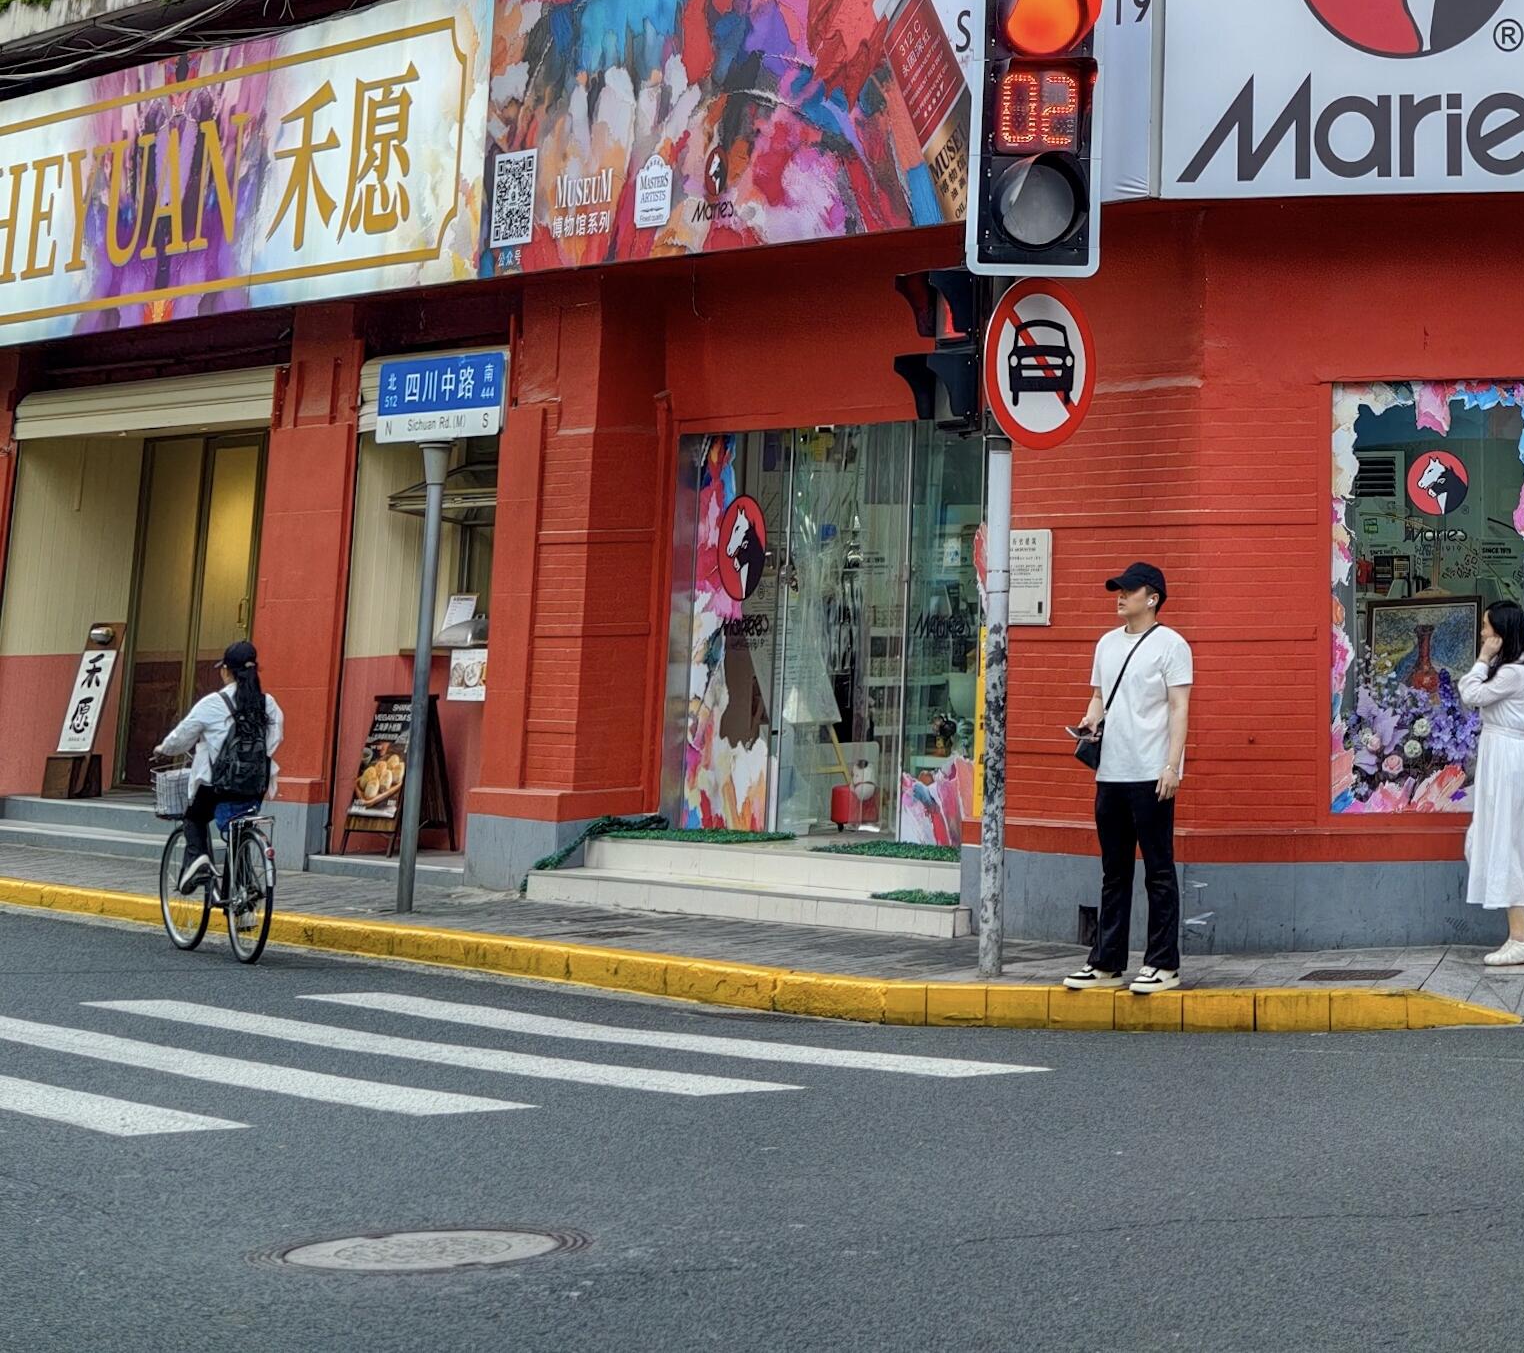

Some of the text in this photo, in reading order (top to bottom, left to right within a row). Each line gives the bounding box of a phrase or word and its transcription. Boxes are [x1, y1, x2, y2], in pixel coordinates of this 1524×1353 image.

[900, 32, 914, 56] 312
[1002, 73, 1077, 146] 02
[0, 61, 420, 284] HEYUAN 禾愿
[552, 210, 611, 238] 博物馆系列
[498, 249, 522, 267] 公众号
[384, 386, 495, 408] 512 444
[387, 363, 494, 403] 北 四川中路 南
[385, 420, 392, 435] N
[407, 419, 436, 432] Sichuan
[482, 412, 489, 428] S
[70, 653, 104, 733] 禾愿
